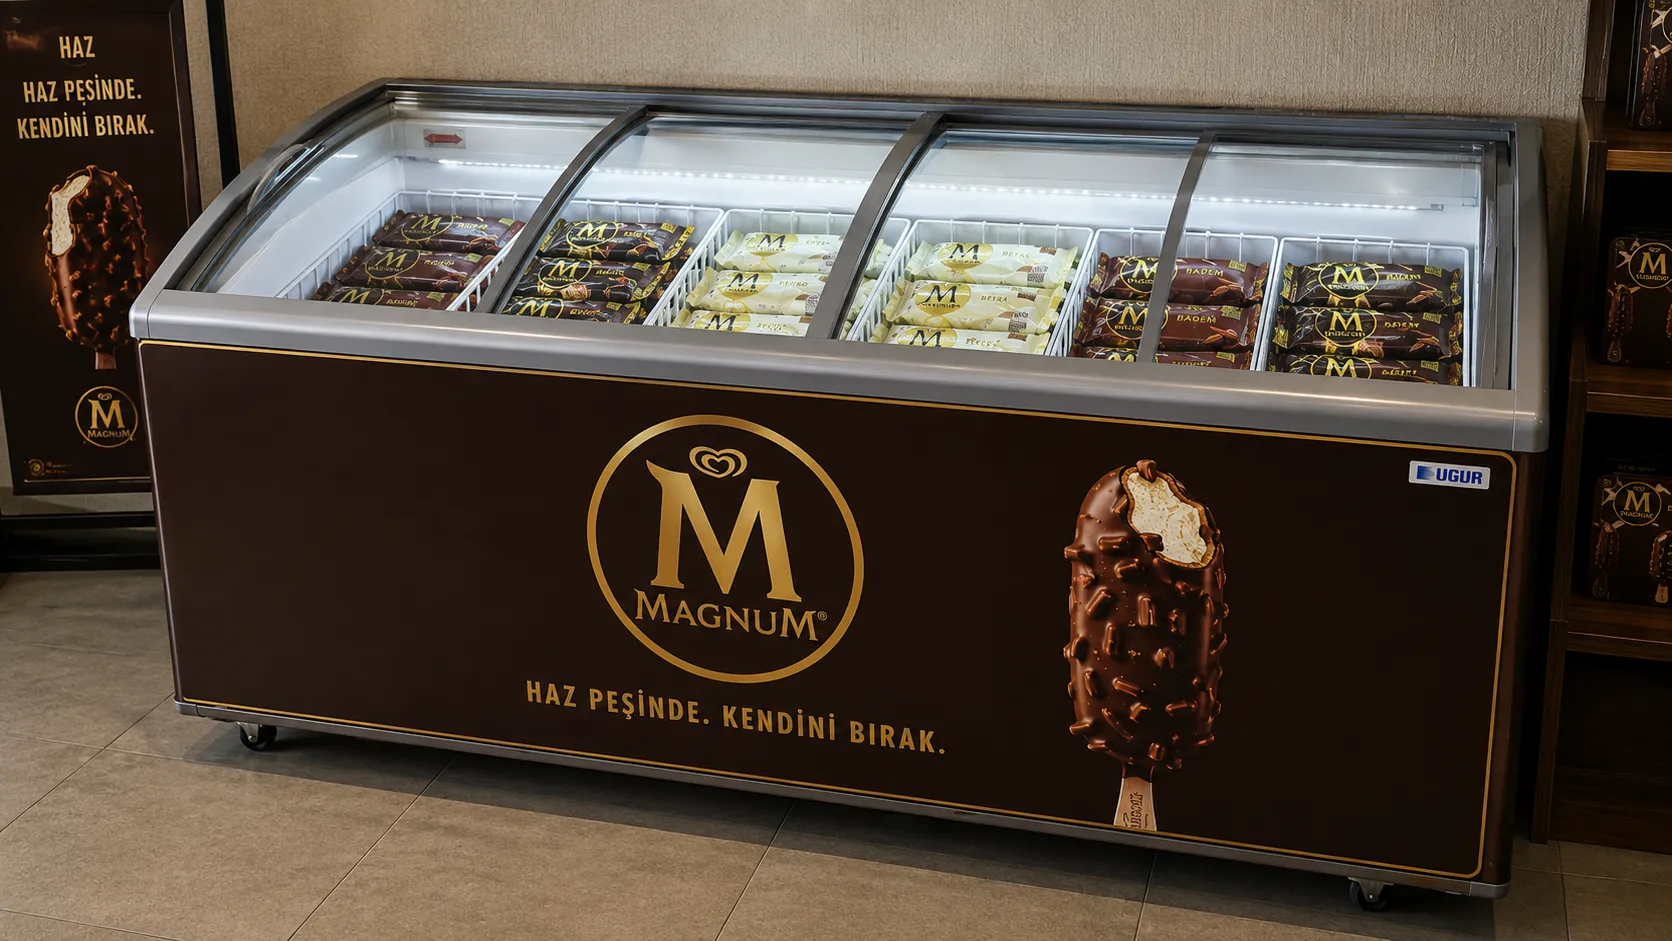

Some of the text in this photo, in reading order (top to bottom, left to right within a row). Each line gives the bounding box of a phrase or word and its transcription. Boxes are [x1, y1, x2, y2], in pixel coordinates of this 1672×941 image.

[58, 36, 95, 59] HAZ
[23, 81, 58, 103] HAZ
[17, 111, 155, 139] KENDİNİ BIRAK.
[1332, 266, 1365, 284] M
[1639, 251, 1667, 275] M
[1329, 311, 1363, 332] M
[88, 399, 126, 429] M
[1436, 467, 1483, 485] UGUR
[1623, 489, 1651, 513] M
[645, 459, 802, 602] M
[526, 679, 946, 755] HAZ PEŞİNDE. KENDİNİ BIRAK.
